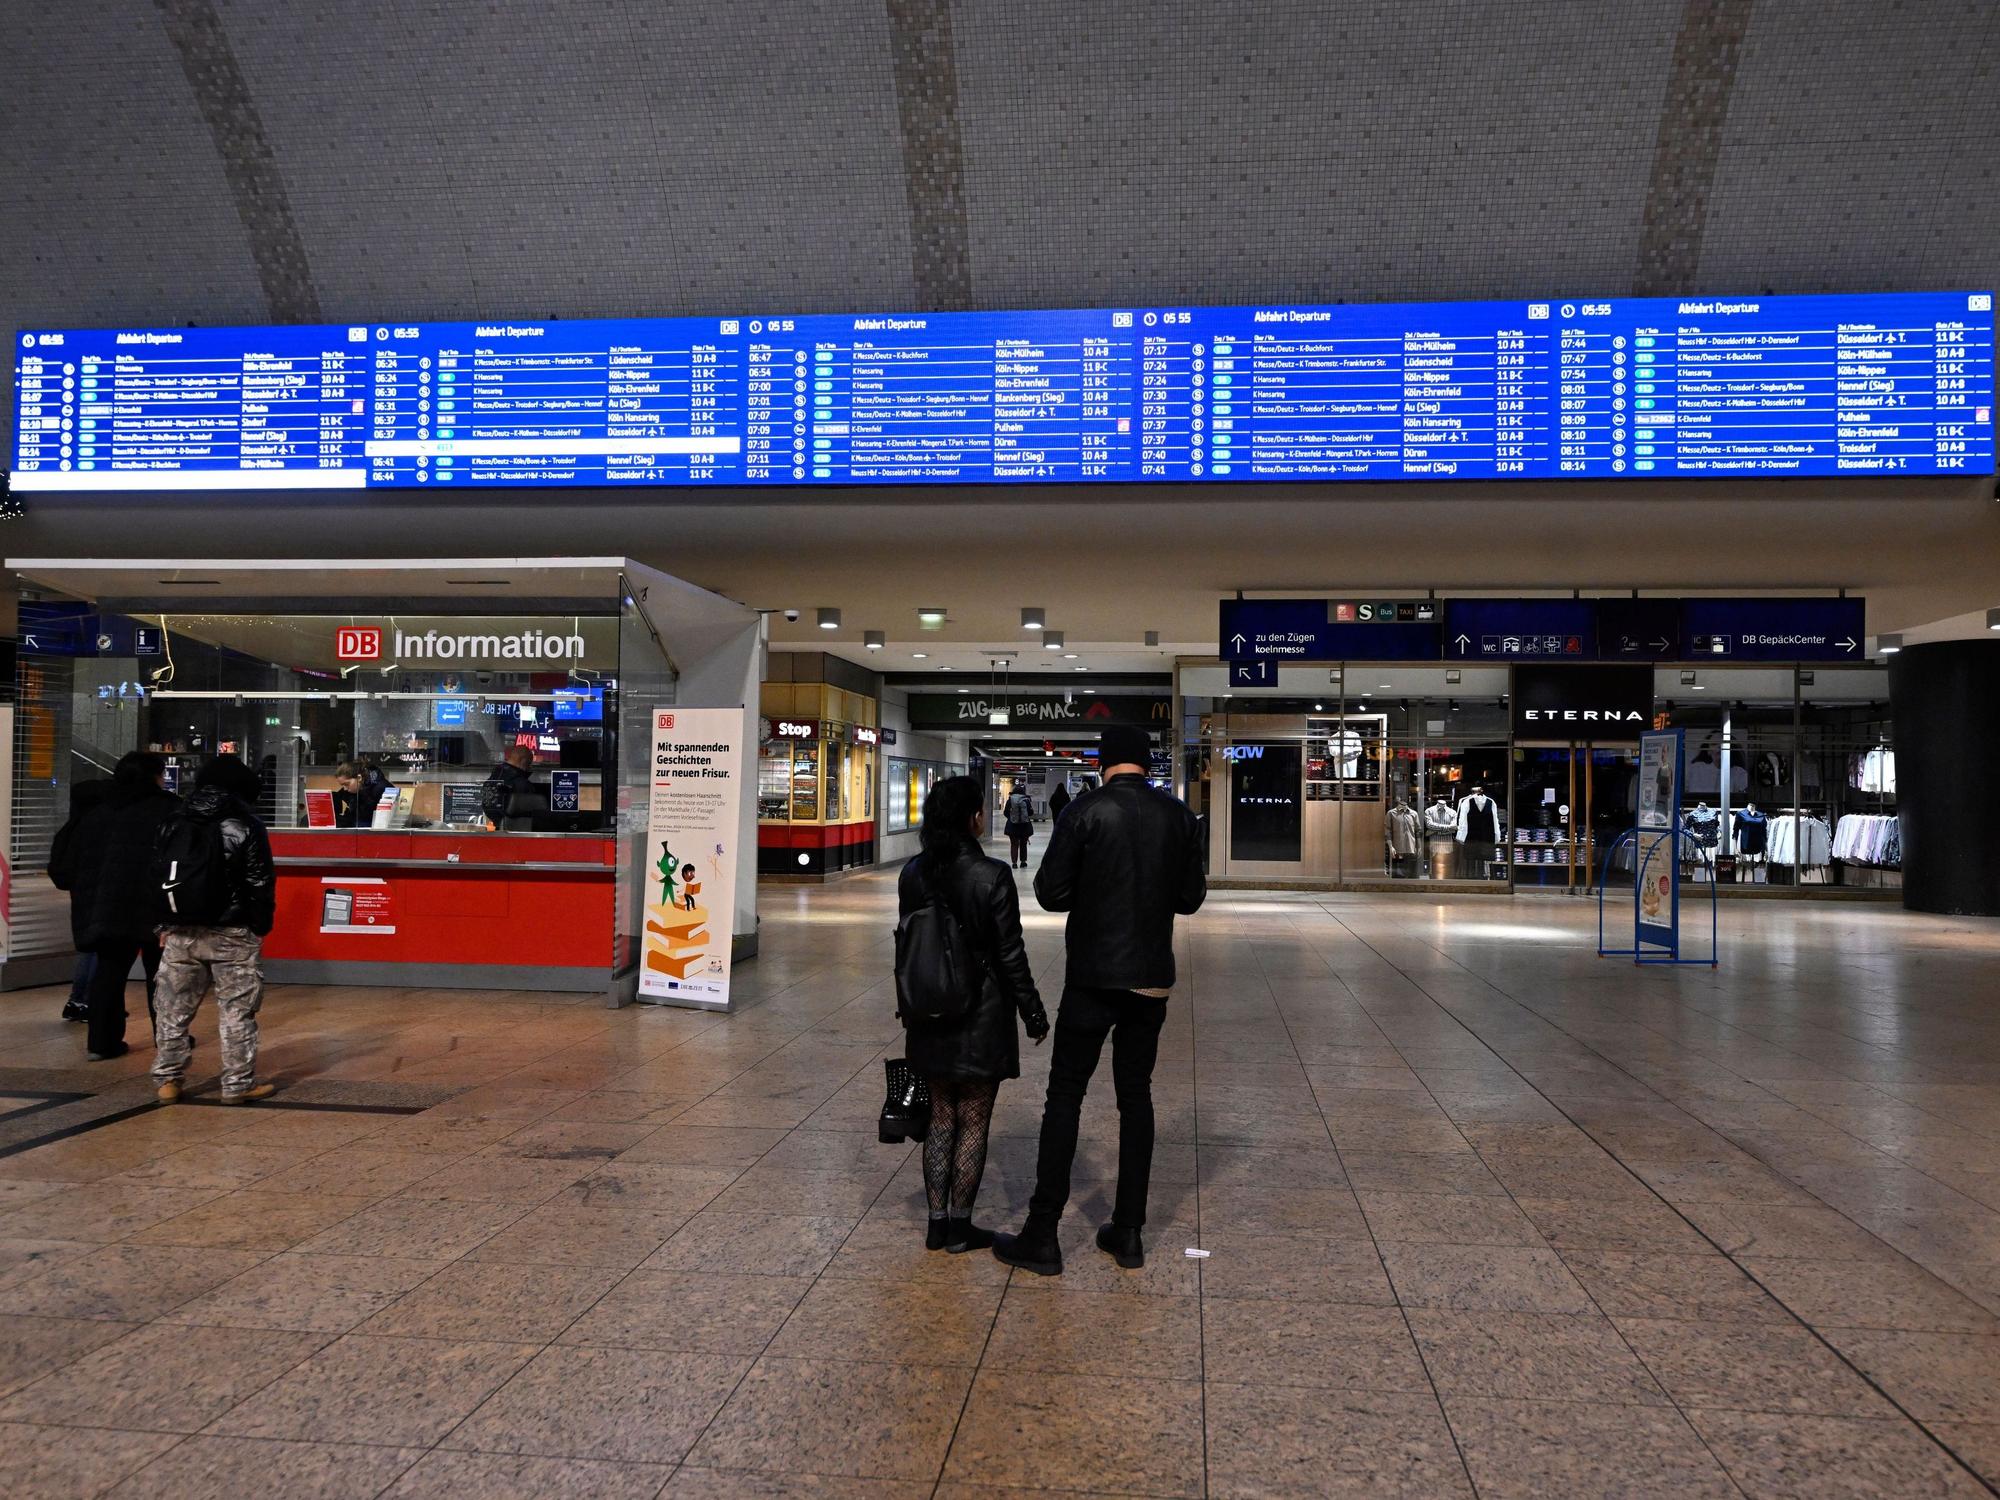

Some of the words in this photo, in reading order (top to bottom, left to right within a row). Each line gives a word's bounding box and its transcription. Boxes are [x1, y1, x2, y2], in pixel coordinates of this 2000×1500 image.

[1582, 305, 1611, 315] 05:55
[1678, 304, 1713, 314] Abfahrt
[1716, 304, 1759, 314] Departure
[1254, 312, 1288, 322] Abfahrt
[1290, 312, 1331, 323] Departure
[854, 320, 885, 329] Abfahrt
[888, 320, 926, 331] Departure
[476, 327, 505, 337] Abfahrt
[507, 327, 544, 337] Departure
[1404, 341, 1455, 351] Köln-Mülheim
[1497, 341, 1509, 349] 10
[1510, 340, 1524, 349] A-B
[1562, 340, 1586, 348] 07:44
[996, 349, 1044, 358] Köln-Mülheim
[1084, 348, 1095, 356] 10
[1096, 347, 1108, 356] A-B
[1144, 346, 1167, 356] 07:17
[750, 354, 772, 362] 06:47
[1404, 357, 1453, 366] Lüdenscheid
[1497, 356, 1509, 365] 10
[1510, 356, 1524, 364] A-B
[1562, 355, 1586, 364] 07:47
[996, 364, 1038, 374] Köln-Nippes
[1084, 363, 1093, 371] 11
[1095, 363, 1107, 371] B-C
[1144, 362, 1167, 371] 07:24
[750, 368, 771, 377] 06:54
[1497, 371, 1507, 379] 11
[1510, 371, 1523, 379] B-C
[1562, 370, 1586, 379] 07:54
[1084, 378, 1093, 386] 11
[1095, 378, 1107, 386] B-C
[1144, 377, 1167, 386] 07:24
[1404, 373, 1449, 383] Köln-Nippes
[749, 383, 771, 392] 07:00
[995, 379, 1049, 387] Köln-Ehrenfeld
[1404, 387, 1461, 396] Köln-Ehrenfeld
[1497, 387, 1507, 395] 11
[1510, 386, 1523, 395] B-C
[1562, 386, 1586, 394] 08:01
[995, 394, 1040, 403] Blankenberg
[1043, 392, 1064, 403] (Sieg)
[1083, 393, 1094, 401] 10
[1095, 392, 1108, 400] A-B
[1144, 392, 1167, 400] 07:30
[749, 398, 770, 406] 07:01
[995, 408, 1034, 416] Düsseldorf
[1095, 407, 1108, 415] A-B
[749, 412, 770, 420] 07:07
[1562, 416, 1586, 425] 08:09
[1144, 421, 1166, 430] 07:37
[1404, 418, 1421, 427] Köln
[1423, 418, 1461, 428] Hansaring
[1497, 417, 1507, 425] 11
[1509, 417, 1522, 425] B-C
[748, 426, 770, 435] 07:09
[995, 423, 1023, 431] Pulheim
[1143, 436, 1166, 445] 07:37
[1404, 433, 1446, 442] Düsseldorf
[1497, 432, 1509, 441] 10
[1510, 432, 1523, 440] A-B
[1562, 432, 1586, 440] 08:10
[748, 441, 770, 449] 07:10
[995, 438, 1016, 446] Düren
[1083, 437, 1092, 445] 11
[1094, 437, 1106, 445] B-C
[1082, 452, 1094, 460] 10
[1143, 451, 1166, 460] 07:40
[1404, 448, 1427, 457] Düren
[1497, 447, 1506, 456] 11
[1509, 447, 1522, 455] B-C
[1562, 447, 1586, 456] 08:11
[748, 455, 769, 464] 07:11
[994, 453, 1021, 461] Hennef
[1022, 452, 1044, 462] (Sieg)
[1143, 466, 1166, 474] 07:41
[1404, 463, 1431, 472] Hennef
[1434, 462, 1457, 474] (Sieg)
[1496, 463, 1509, 471] 10
[1510, 463, 1523, 471] A-B
[1269, 633, 1285, 642] den
[1288, 633, 1314, 644] Zügen
[1743, 635, 1757, 644] DB
[1759, 634, 1826, 646] GepäckCenter
[395, 629, 584, 658] Information
[1484, 644, 1496, 652] WC
[1255, 646, 1305, 654] koelnmesse
[1258, 661, 1265, 678] 1
[958, 700, 987, 718] ZUG
[1526, 710, 1643, 720] ETERNA
[778, 722, 811, 738] Stop
[658, 742, 672, 752] Mit
[674, 743, 729, 754] spannenden
[656, 755, 711, 765] Geschichten
[656, 769, 670, 777] zur
[672, 769, 699, 777] neuen
[702, 768, 730, 778] Frisur.
